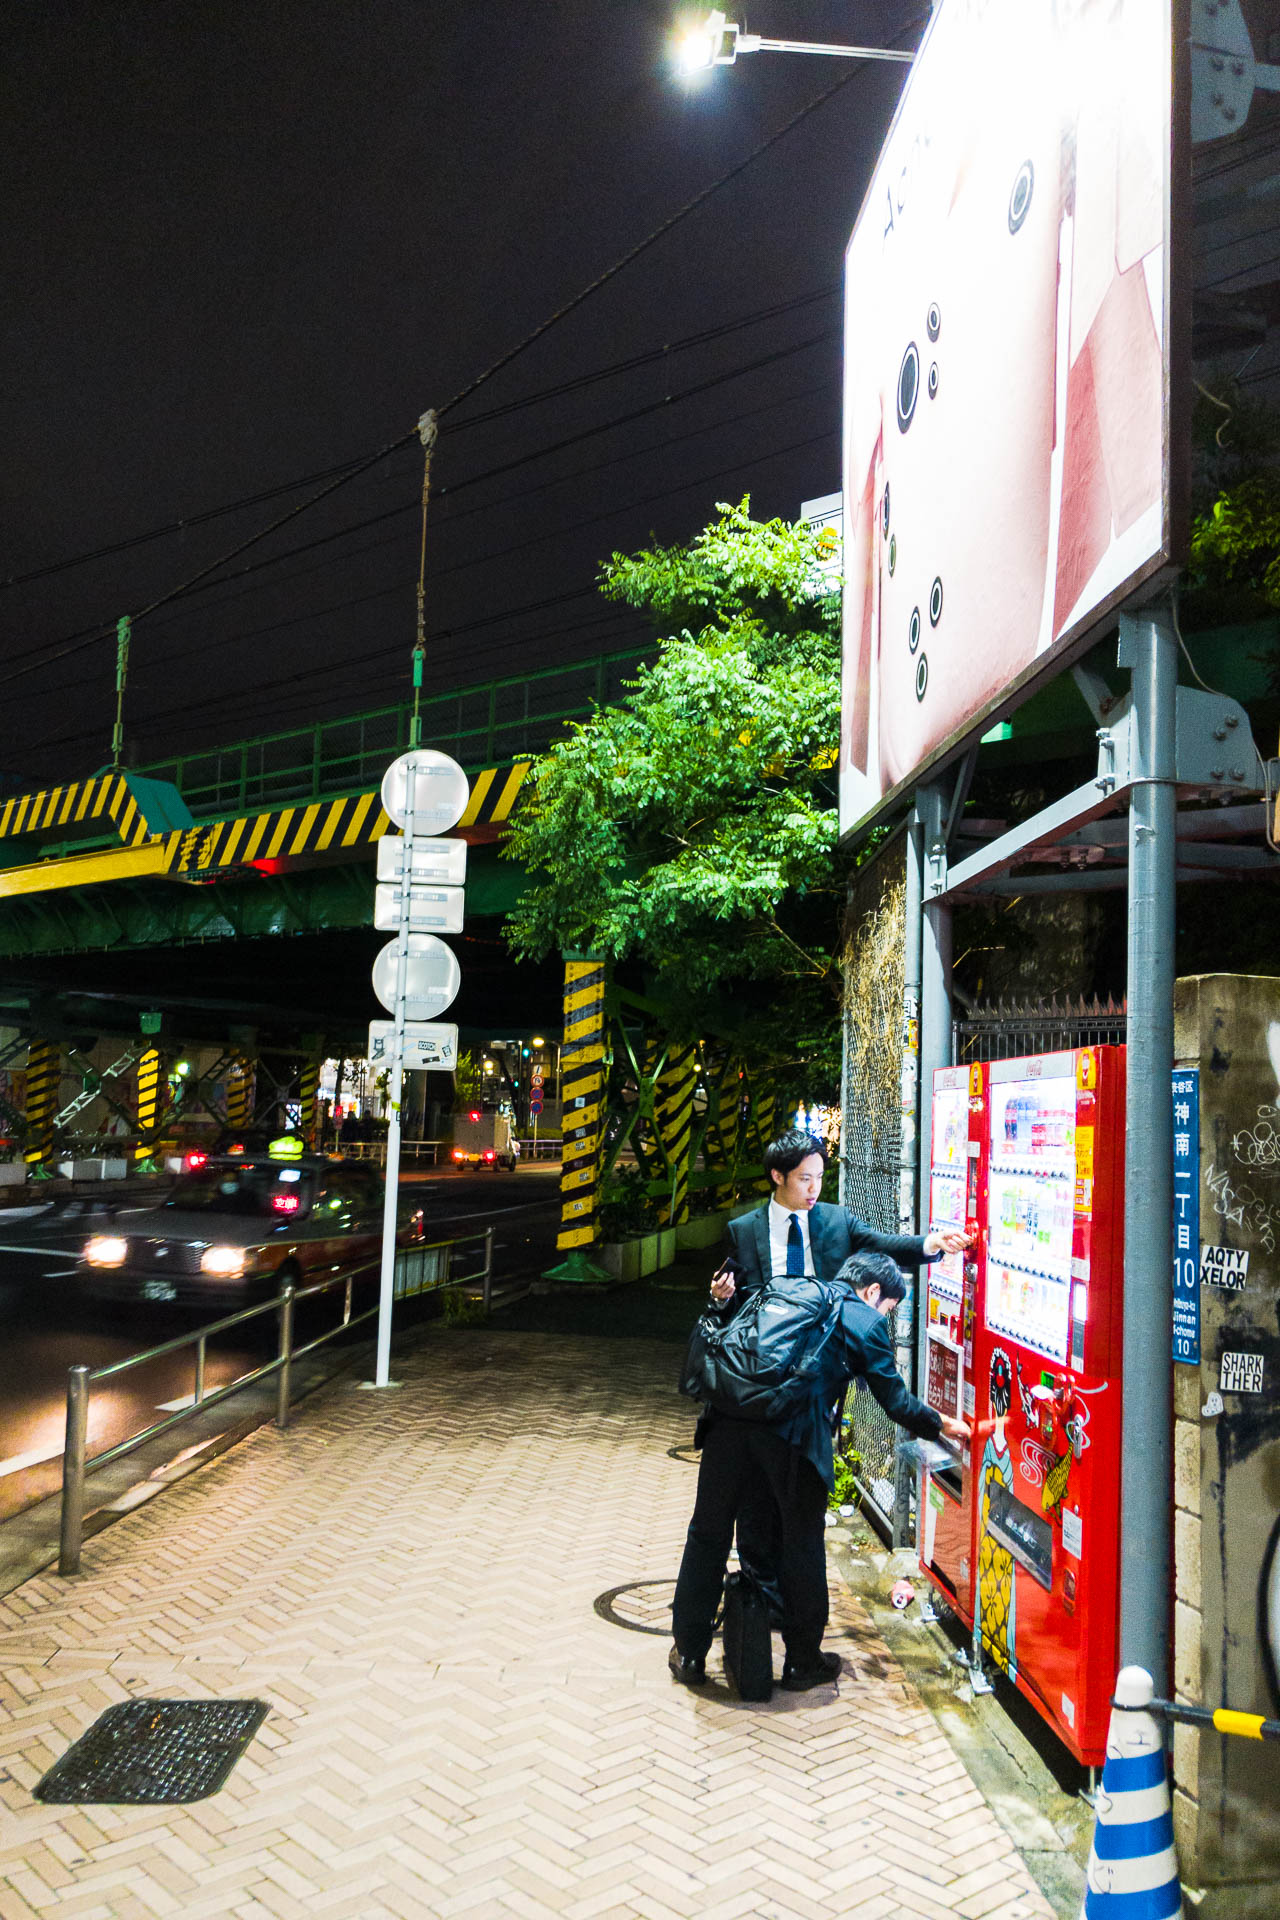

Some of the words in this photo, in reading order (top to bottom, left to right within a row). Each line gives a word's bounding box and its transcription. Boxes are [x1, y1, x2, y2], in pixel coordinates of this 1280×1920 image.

[1174, 1101, 1191, 1250] 神南一丁目
[1205, 1246, 1245, 1269] AQTY
[1173, 1257, 1195, 1289] 10
[1200, 1266, 1245, 1289] XELOR
[1177, 1338, 1190, 1356] 10
[1223, 1353, 1263, 1374] SHARK
[1222, 1371, 1262, 1392] THER
